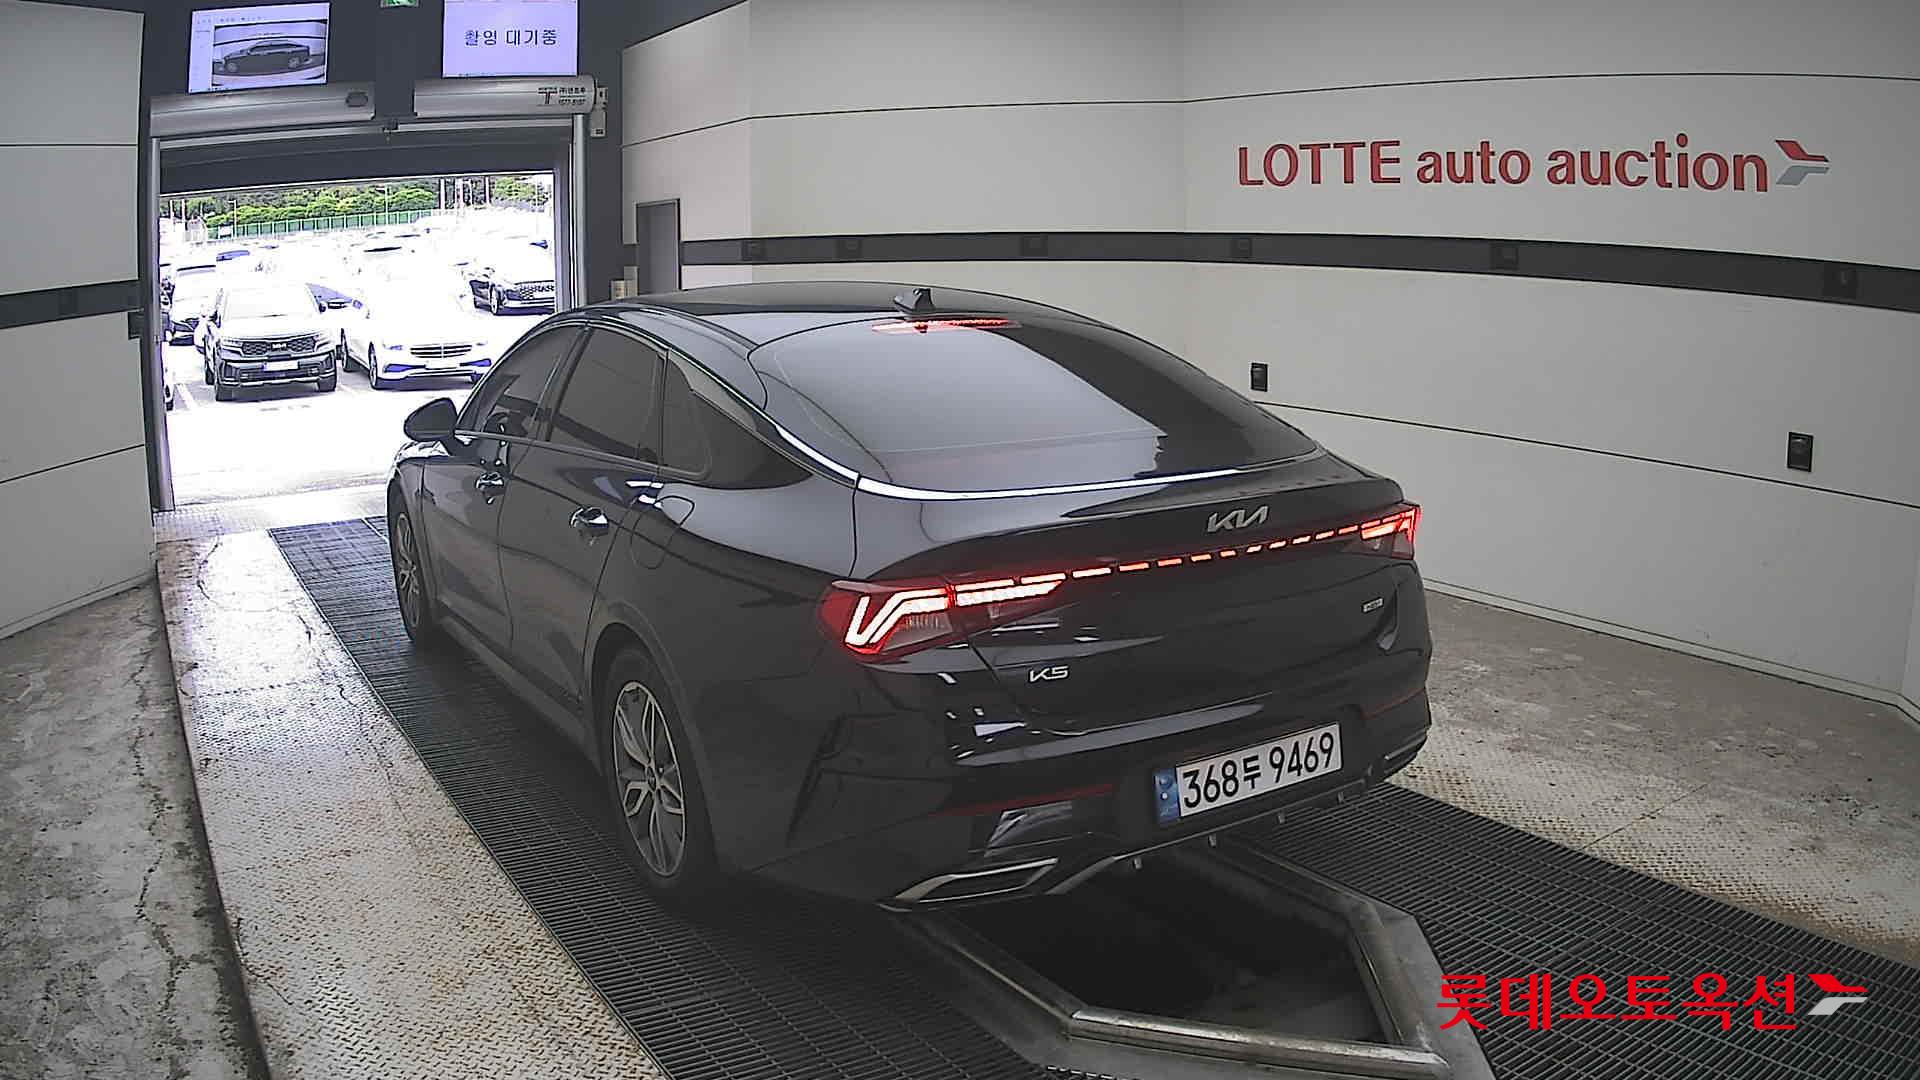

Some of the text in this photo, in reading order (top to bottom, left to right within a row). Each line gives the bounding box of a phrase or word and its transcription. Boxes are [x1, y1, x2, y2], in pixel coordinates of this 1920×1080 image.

[505, 29, 557, 46] 대기중
[1238, 133, 1768, 193] LOTTE auto auction
[1029, 665, 1069, 682] K5
[1182, 732, 1334, 808] 368두 9469
